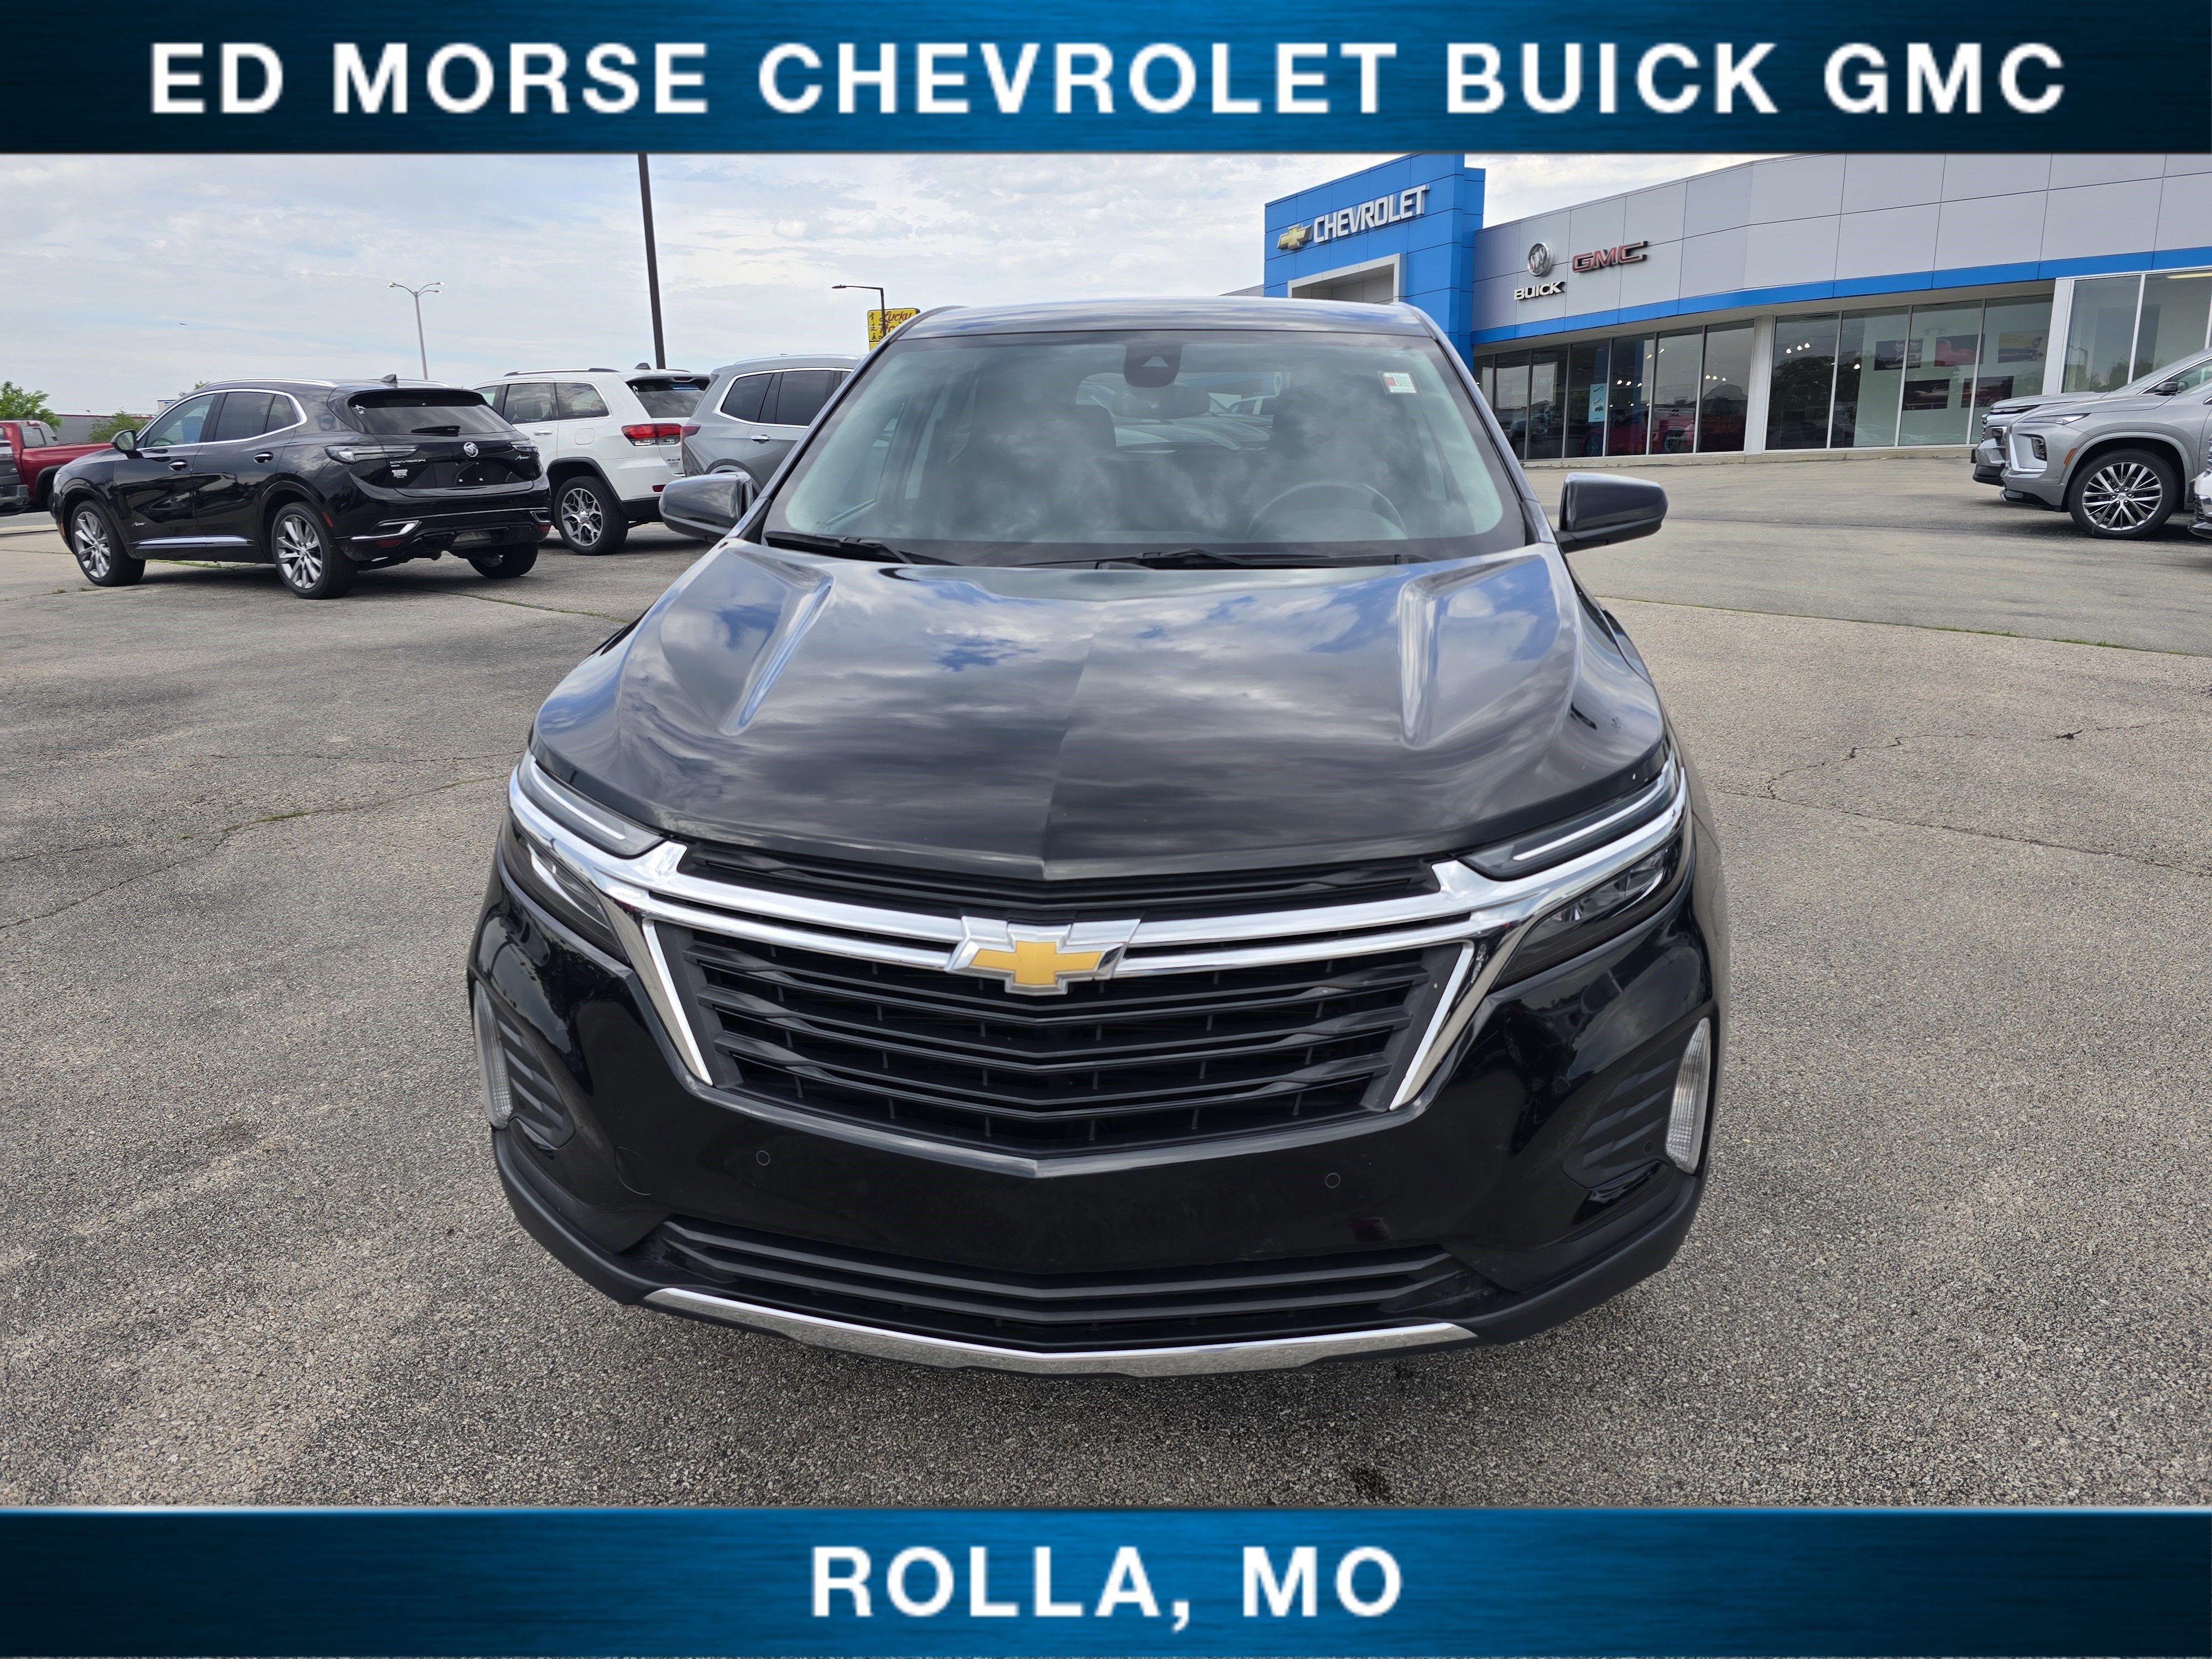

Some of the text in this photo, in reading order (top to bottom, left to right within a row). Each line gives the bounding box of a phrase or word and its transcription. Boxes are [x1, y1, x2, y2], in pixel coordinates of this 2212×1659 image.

[1313, 184, 1430, 243] CHEVROLET
[1572, 241, 1648, 273] GMC
[1514, 281, 1565, 300] BUICK
